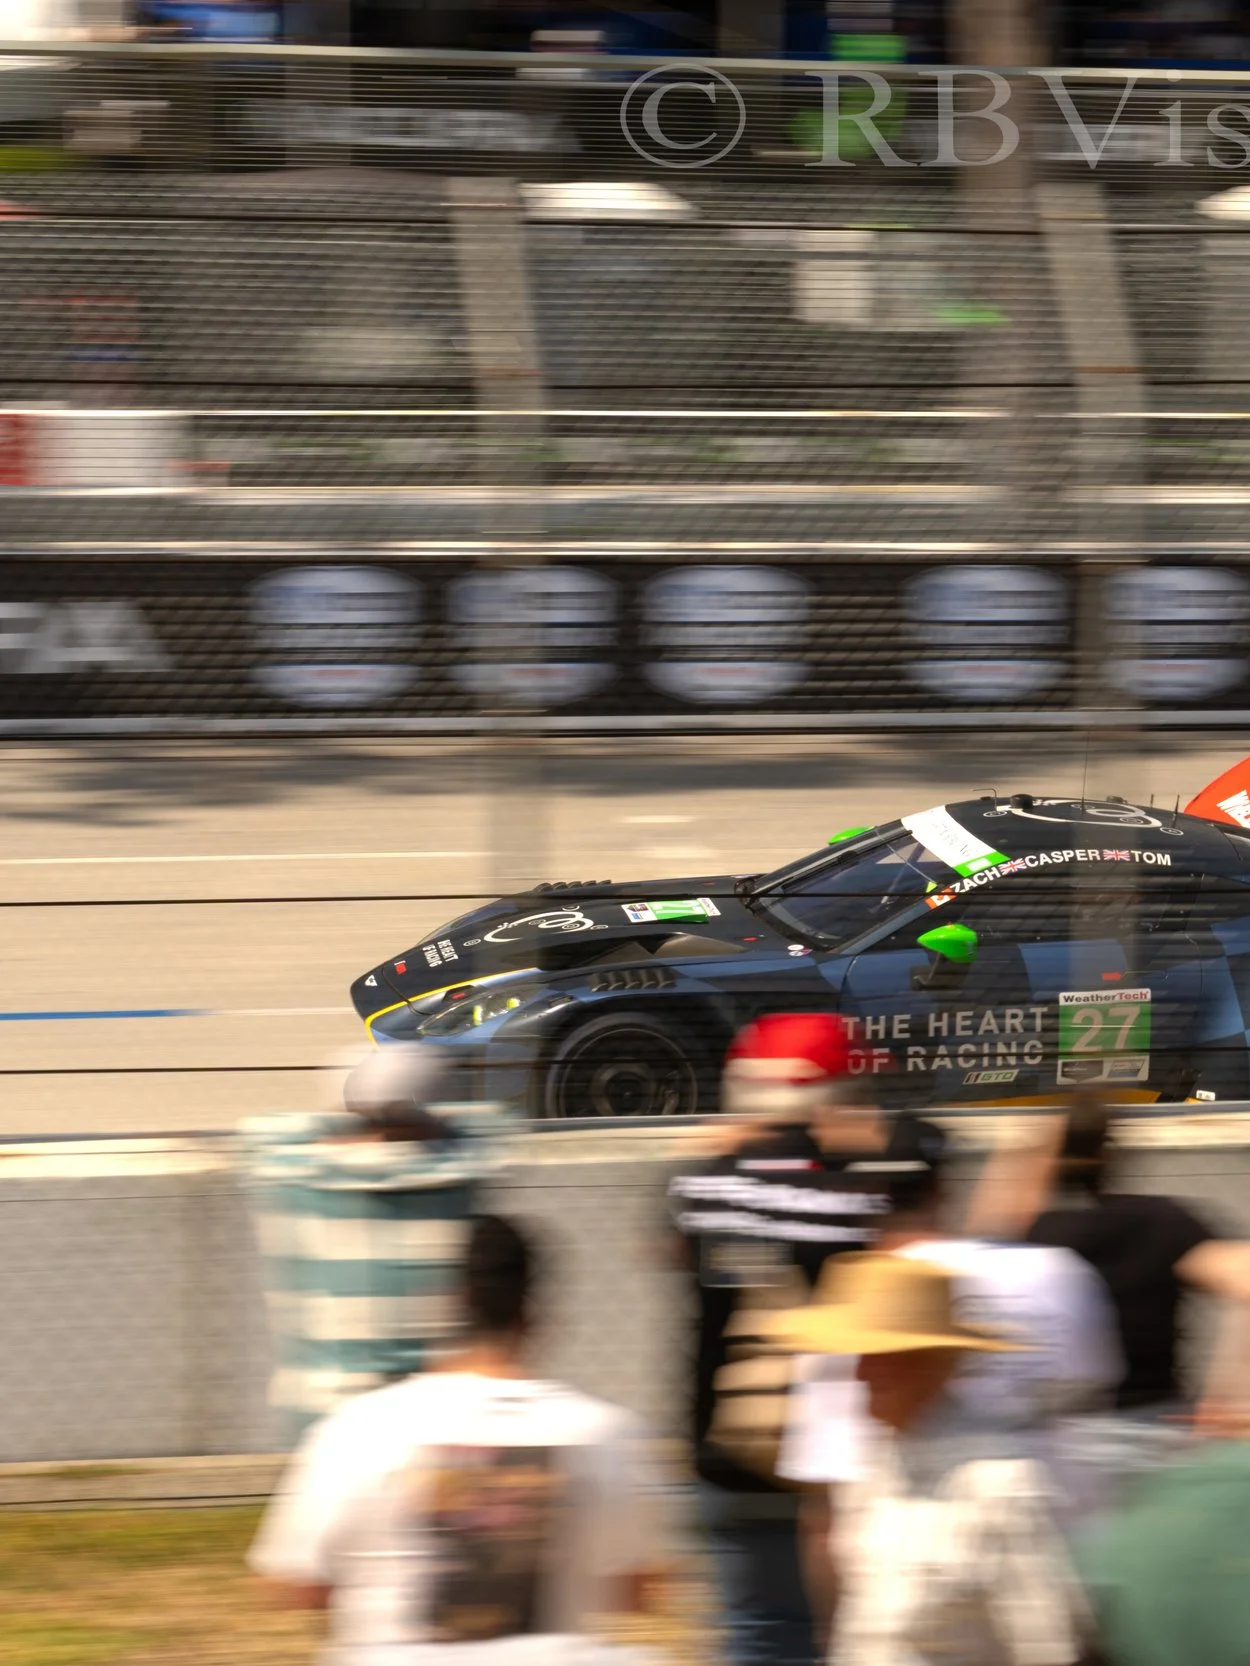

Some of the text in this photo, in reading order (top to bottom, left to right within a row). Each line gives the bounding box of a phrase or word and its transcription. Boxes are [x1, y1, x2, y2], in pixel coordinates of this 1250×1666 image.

[950, 849, 1172, 894] ZACH CASPER TOM
[1063, 991, 1149, 1003] WeatherTech
[841, 1006, 1049, 1040] THE HEART
[1071, 1006, 1141, 1053] 27
[847, 1048, 890, 1075] OF
[906, 1039, 1045, 1072] RACING
[981, 1071, 1015, 1082] GTD
